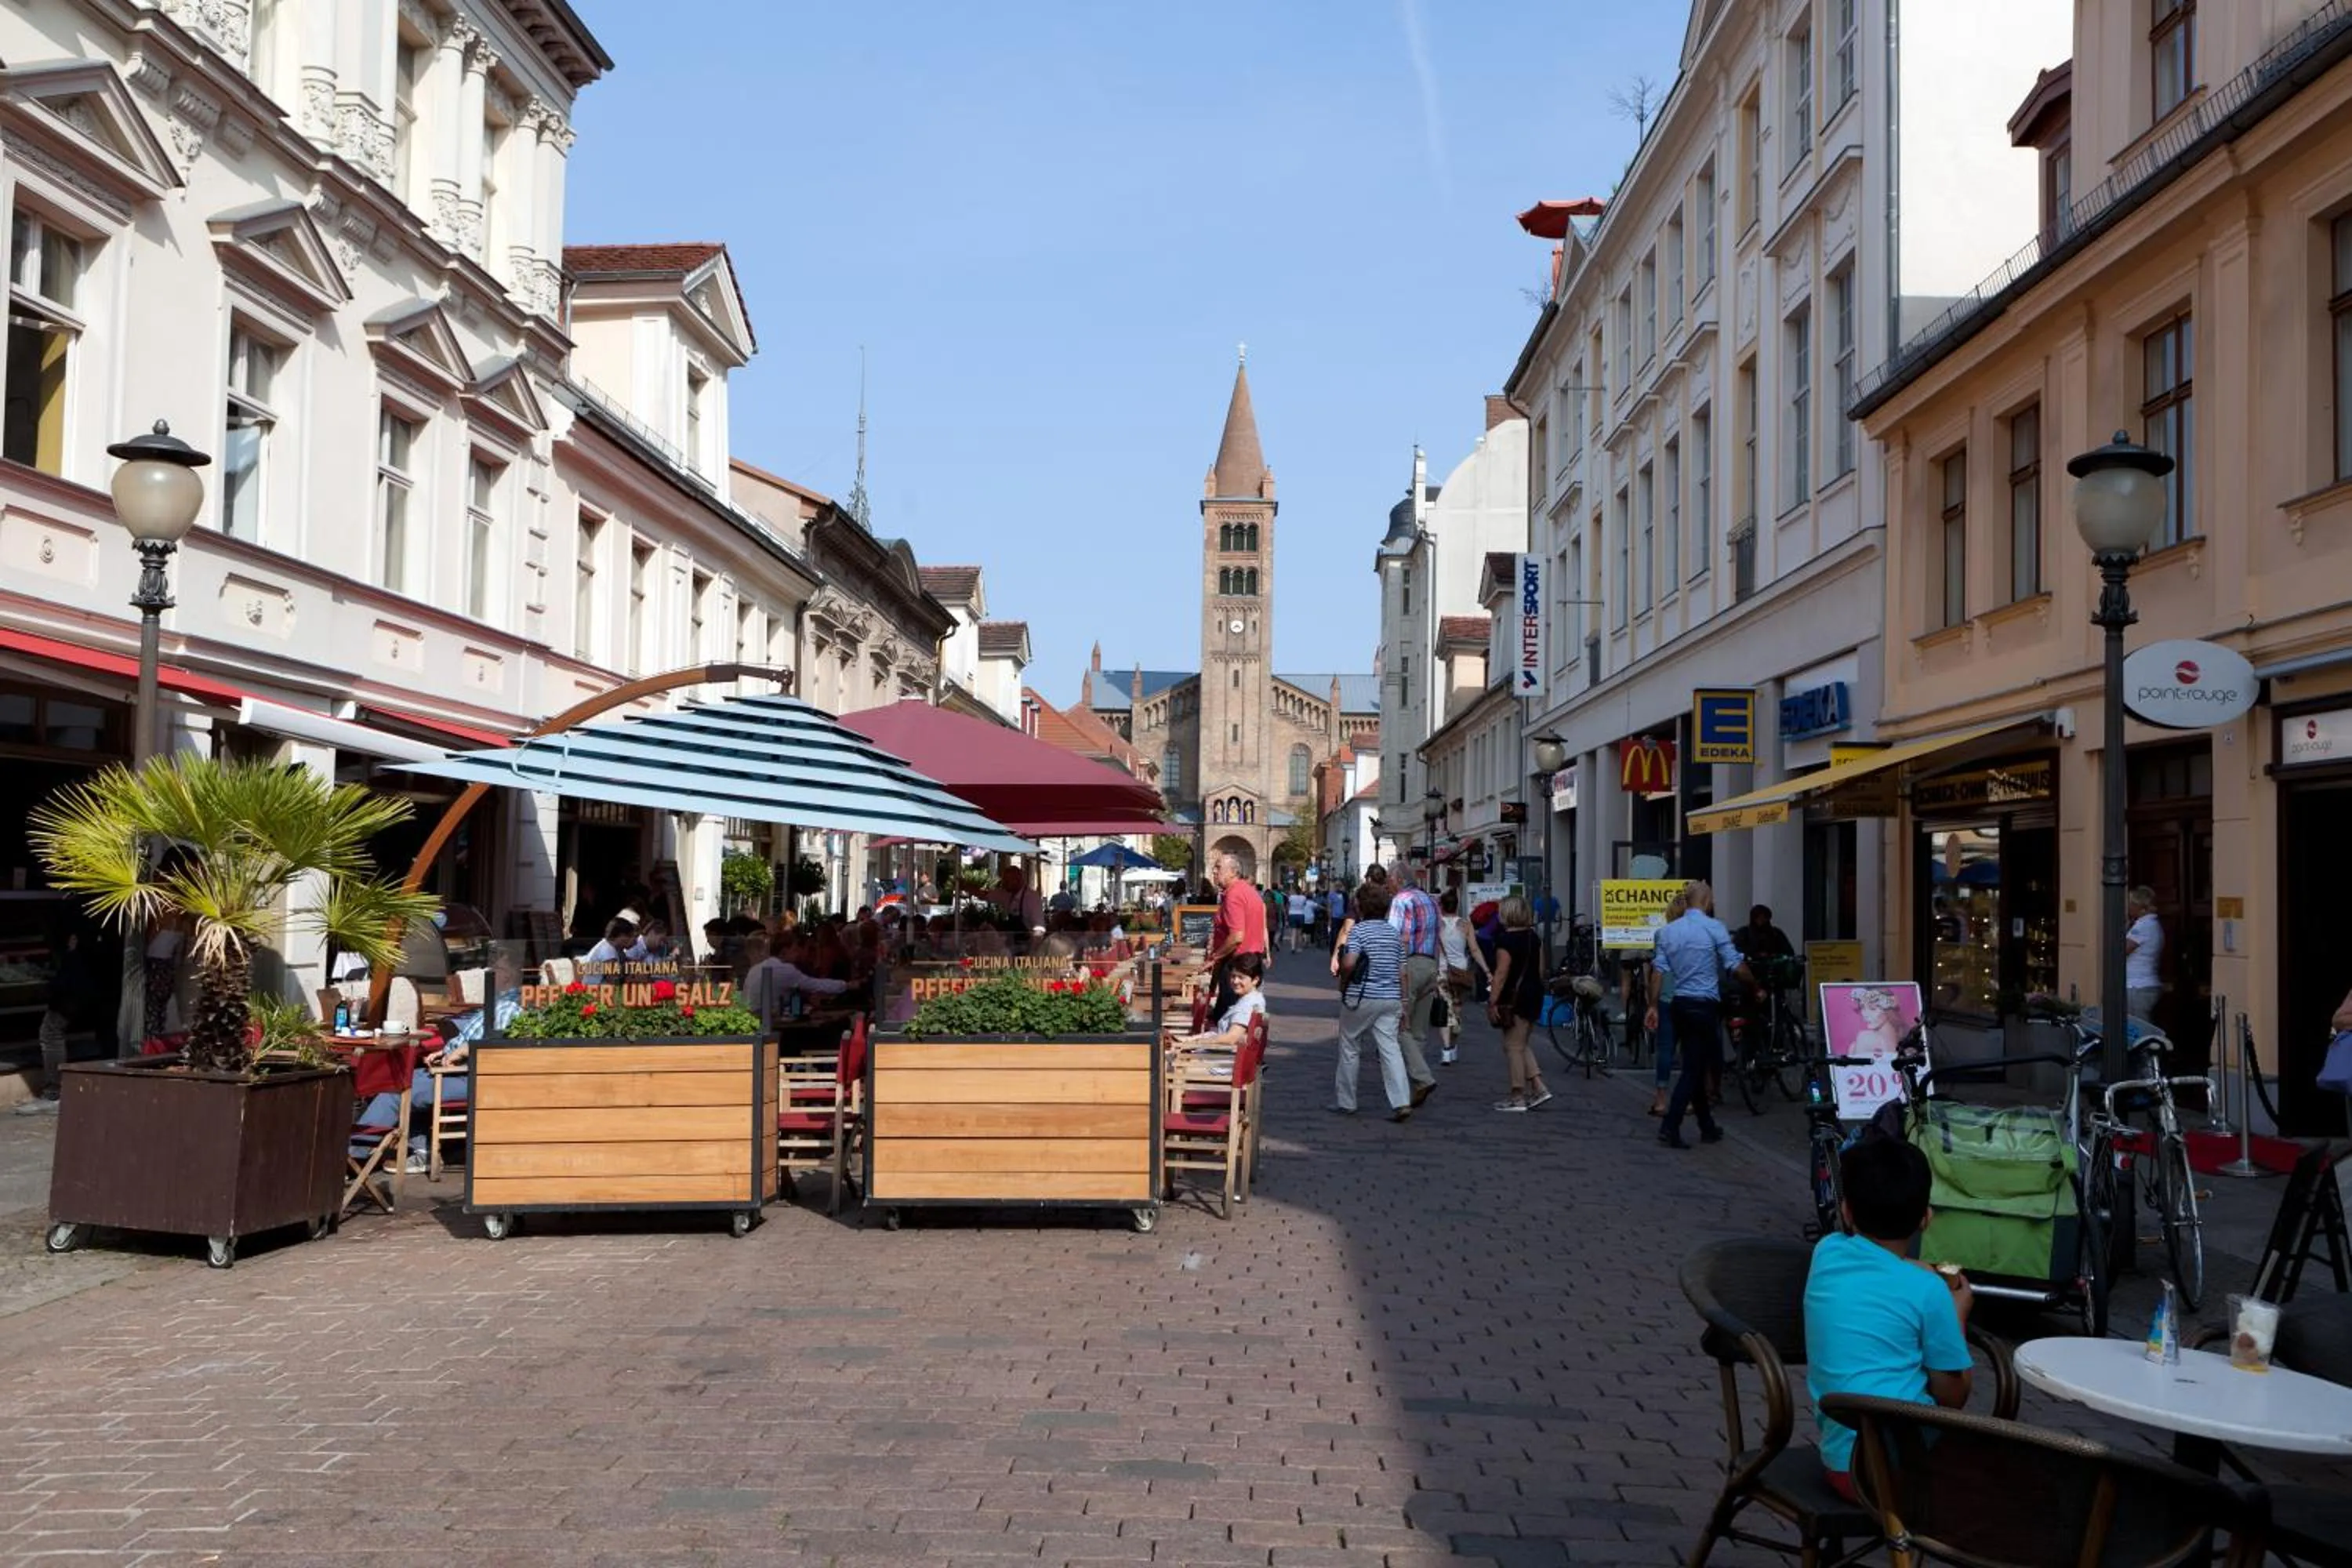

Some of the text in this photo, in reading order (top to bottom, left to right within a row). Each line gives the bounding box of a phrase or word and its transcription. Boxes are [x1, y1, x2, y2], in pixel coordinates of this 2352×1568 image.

[1523, 561, 1538, 667] INTERSPORT
[1700, 747, 1749, 757] EDEKA
[1615, 889, 1683, 903] CHANG
[577, 961, 678, 975] CUCINA ITALIANA
[967, 956, 1068, 969] CUCINA ITALIANA
[521, 982, 731, 1007] PFEER UN SALZ
[1848, 1073, 1886, 1097] 20
